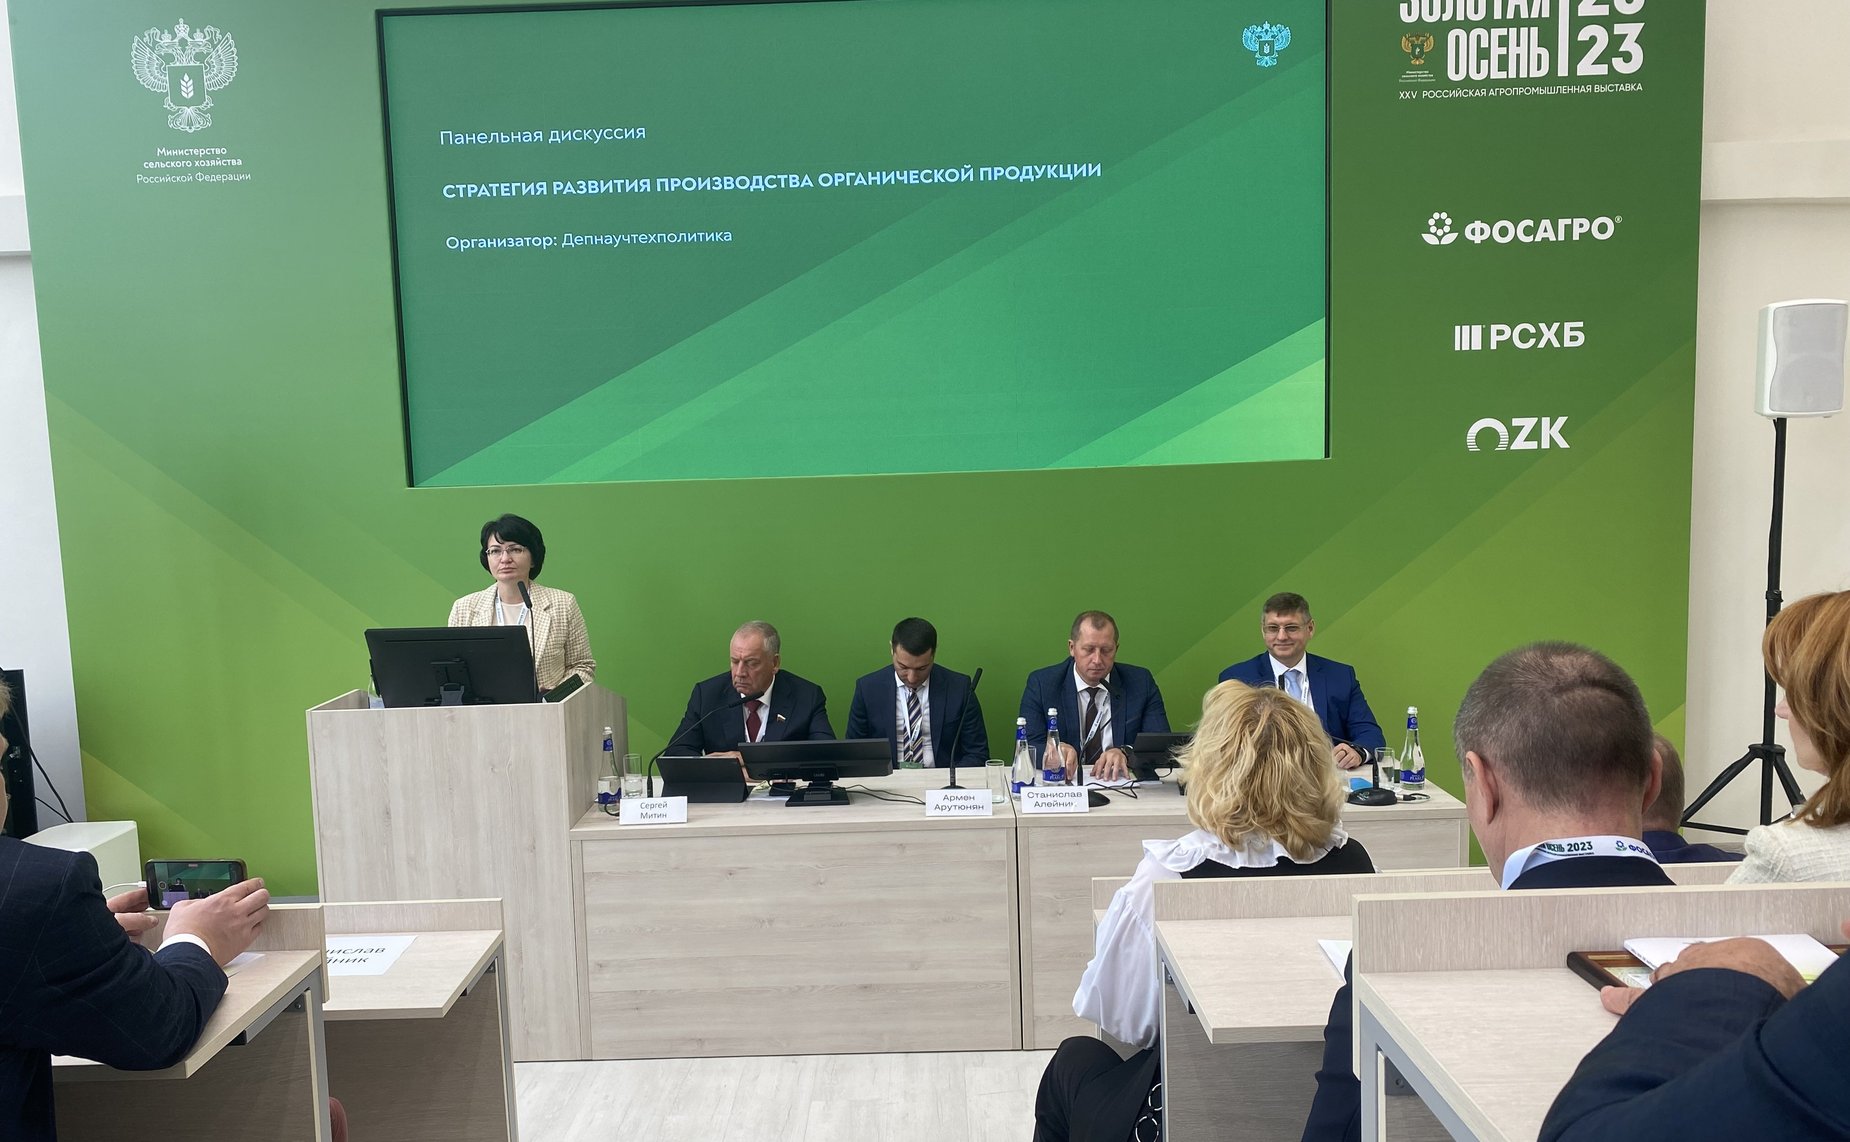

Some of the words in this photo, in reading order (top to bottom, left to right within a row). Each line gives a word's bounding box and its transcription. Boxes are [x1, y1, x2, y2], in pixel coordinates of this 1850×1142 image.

[1447, 26, 1550, 81] ОСЕНЬ
[1576, 22, 1645, 76] 23
[1399, 91, 1418, 99] XXV
[1422, 87, 1487, 99] РОССИЙСКАЯ
[1488, 84, 1592, 97] АГРОПРОМЫШЛЕННАЯ
[1594, 82, 1643, 93] ВЫСТАВКА
[439, 129, 544, 145] Панельная
[548, 127, 646, 144] дискуссия
[156, 147, 227, 158] Министерство
[143, 159, 192, 169] сельского
[194, 157, 243, 167] хозяйства
[136, 173, 193, 183] Российской
[194, 171, 251, 183] Федерации
[442, 180, 548, 199] СТРАТЕГИЯ
[552, 177, 651, 196] РАЗВИТИЯ
[656, 172, 814, 193] ПРОИЗВОДСТВА
[818, 164, 974, 187] ОРГАНИЧЕСКОЙ
[979, 162, 1102, 183] ПРОДУКЦИИ
[446, 235, 558, 251] Организатор:
[561, 230, 733, 248] Депнаучтехполитика
[1490, 321, 1586, 350] РСХБ
[942, 794, 976, 802] Армен
[1026, 791, 1083, 799] Станислав
[640, 801, 668, 810] Сергей
[934, 803, 985, 811] Арутюнян
[640, 812, 667, 820] Митин
[1567, 841, 1593, 852] 2023
